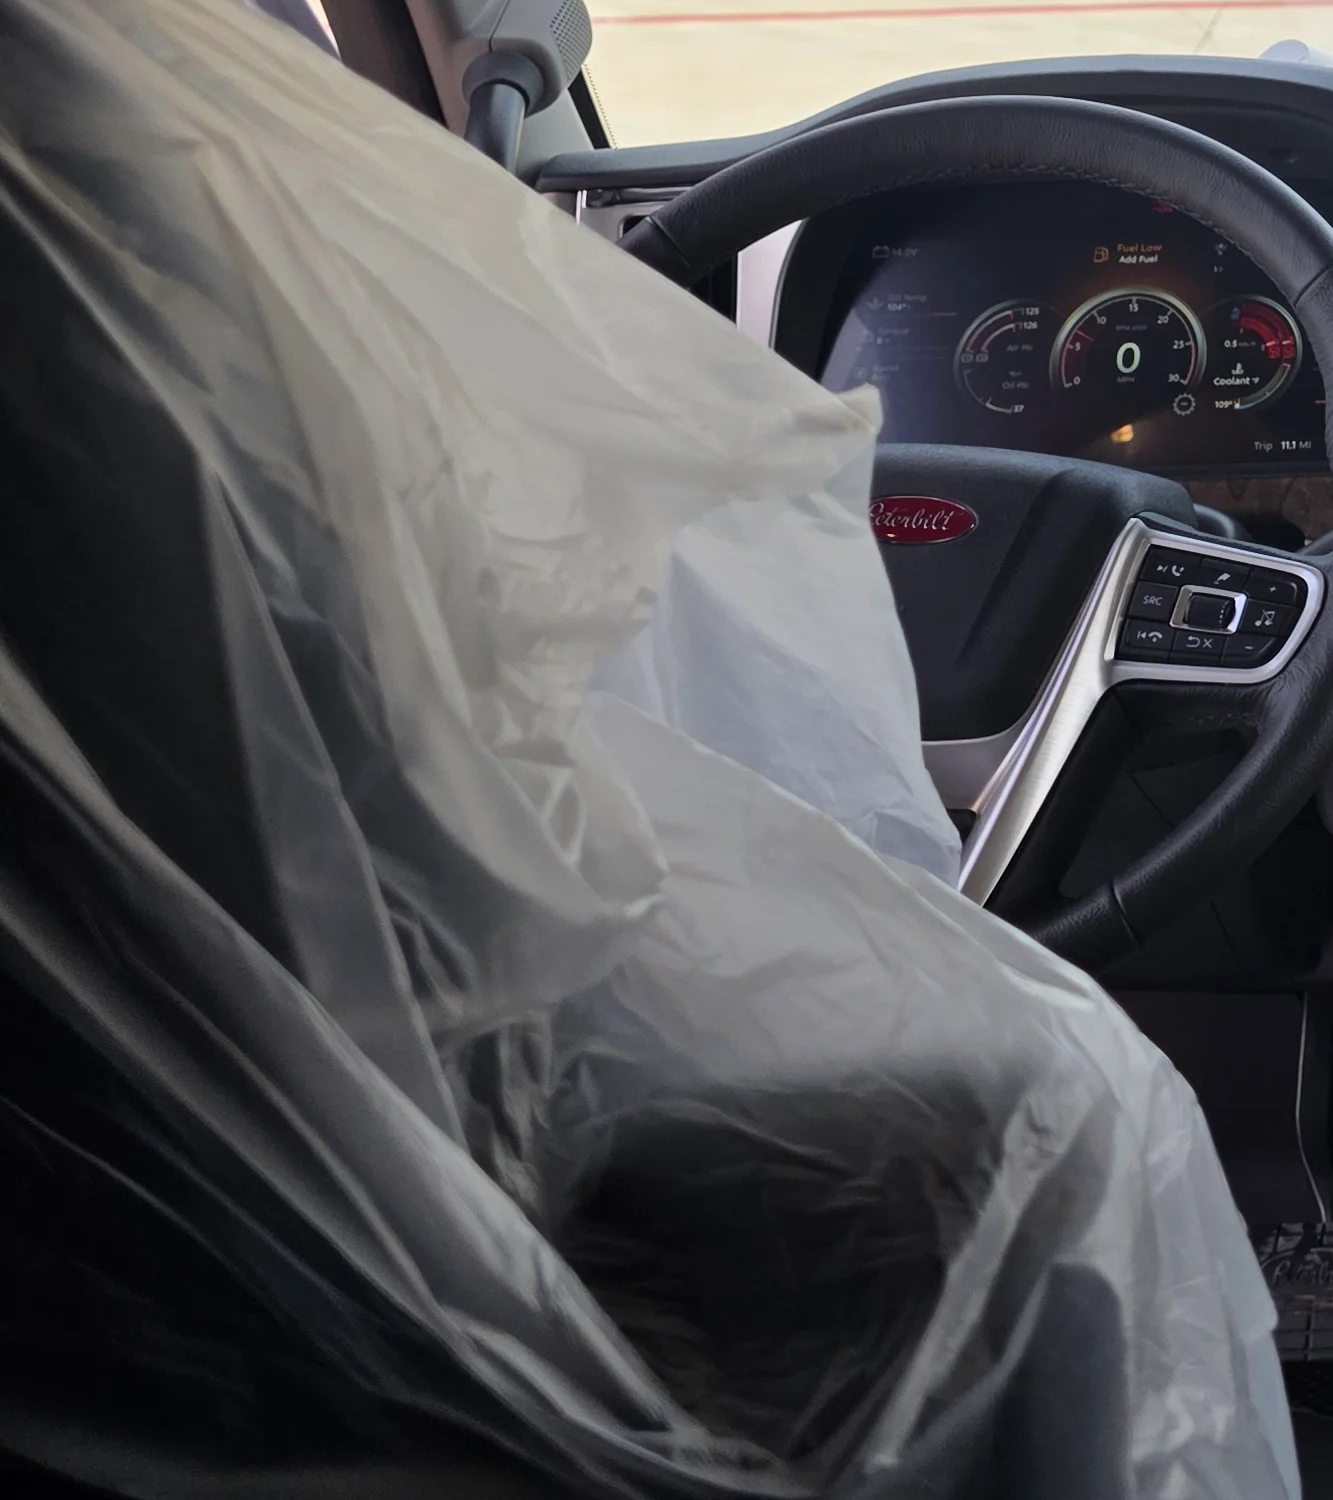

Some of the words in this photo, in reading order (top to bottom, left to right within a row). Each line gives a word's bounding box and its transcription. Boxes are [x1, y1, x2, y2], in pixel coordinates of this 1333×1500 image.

[1117, 244, 1138, 253] Fuel
[1141, 244, 1162, 252] Low
[1119, 255, 1137, 264] Add
[1139, 255, 1158, 263] Fuel
[1129, 303, 1139, 312] 15
[1096, 316, 1107, 325] 10
[1157, 315, 1169, 324] 20
[1073, 342, 1081, 351] 5
[1173, 340, 1185, 349] 25
[1224, 340, 1237, 348] 0.5
[1116, 342, 1141, 373] 0
[1073, 377, 1081, 385] 0
[1168, 374, 1180, 383] 30
[1213, 377, 1250, 386] Coolant
[1254, 442, 1273, 451] Trip
[1280, 441, 1297, 450] 11.1
[1143, 595, 1163, 606] SRC
